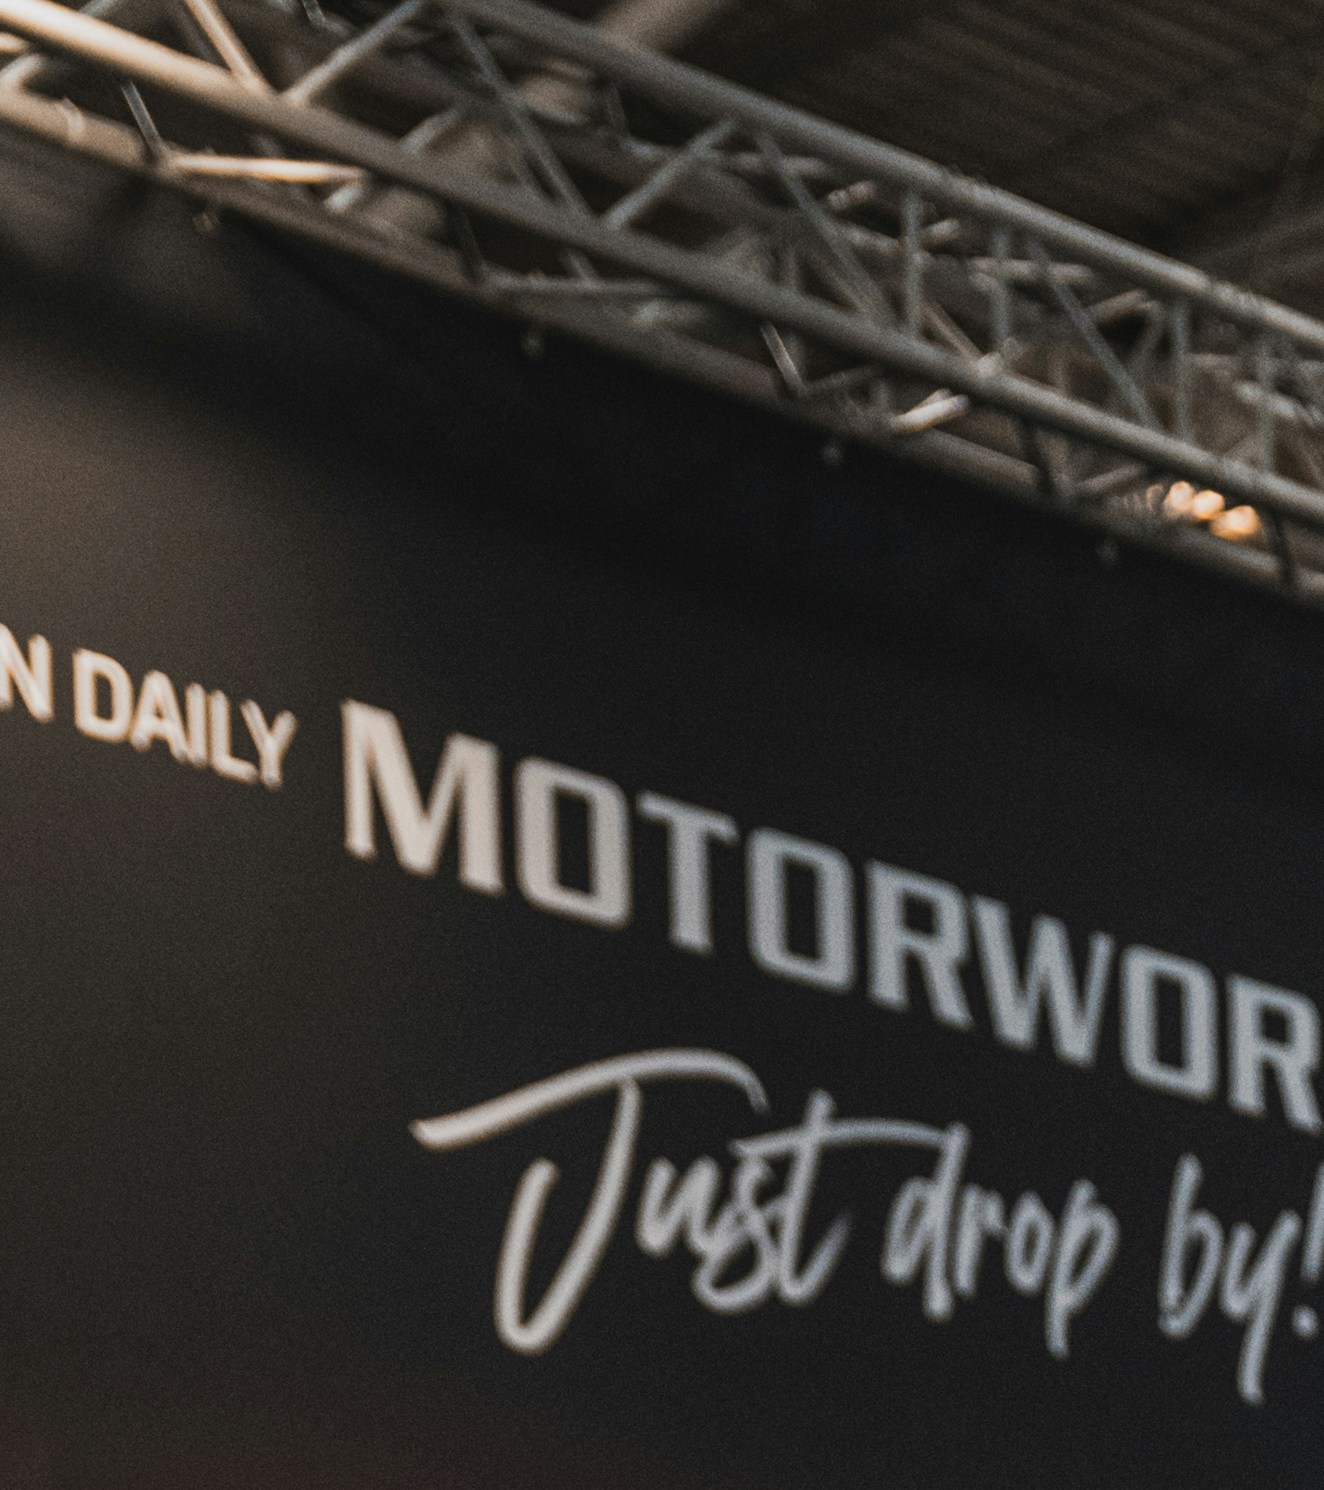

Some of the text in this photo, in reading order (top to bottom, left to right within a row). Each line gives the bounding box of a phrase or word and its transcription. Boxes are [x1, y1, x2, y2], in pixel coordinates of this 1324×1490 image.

[72, 646, 299, 790] DAILY
[410, 1045, 940, 1356] Just
[882, 1122, 1122, 1359] drop
